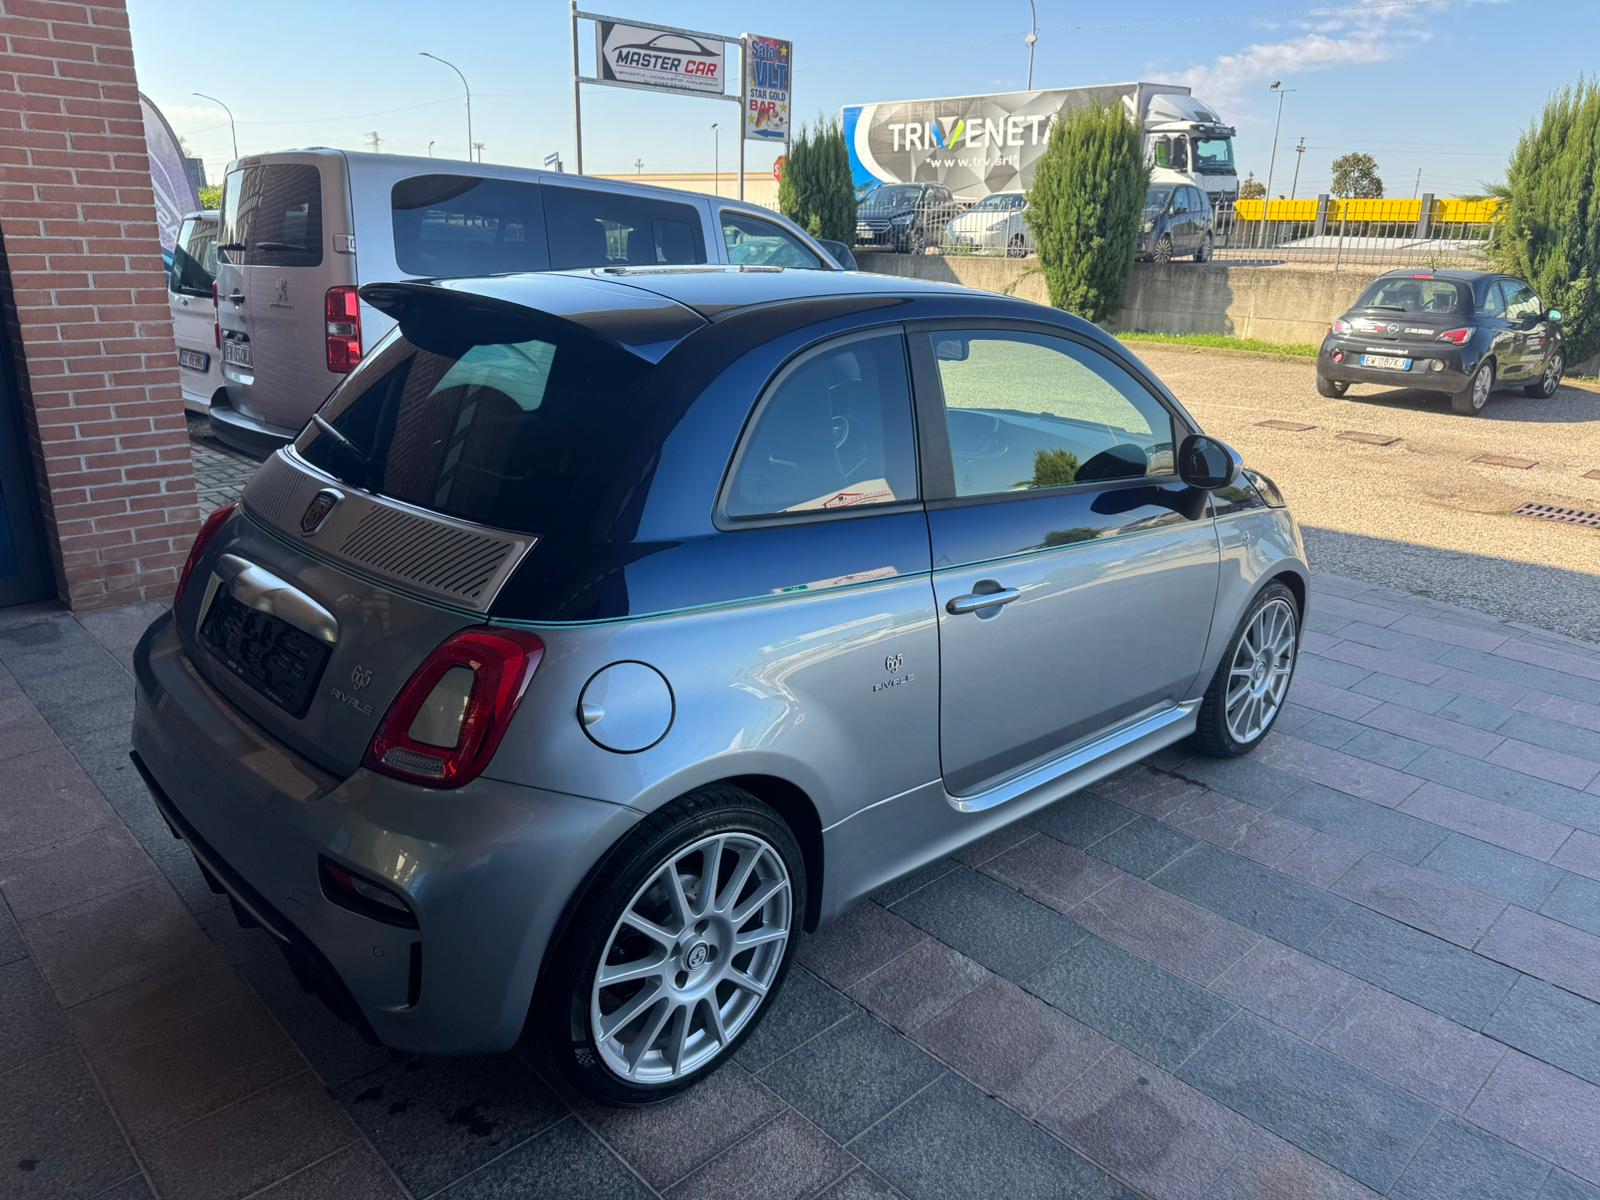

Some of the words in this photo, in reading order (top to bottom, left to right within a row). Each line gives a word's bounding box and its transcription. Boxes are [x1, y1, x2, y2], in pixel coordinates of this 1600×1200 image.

[616, 50, 681, 72] MASTER
[684, 60, 718, 77] CAR
[754, 60, 787, 90] VLT
[749, 99, 776, 113] BAR
[750, 88, 767, 100] STAR
[769, 91, 786, 102] GOLD
[885, 653, 904, 674] 695
[351, 664, 374, 690] 695
